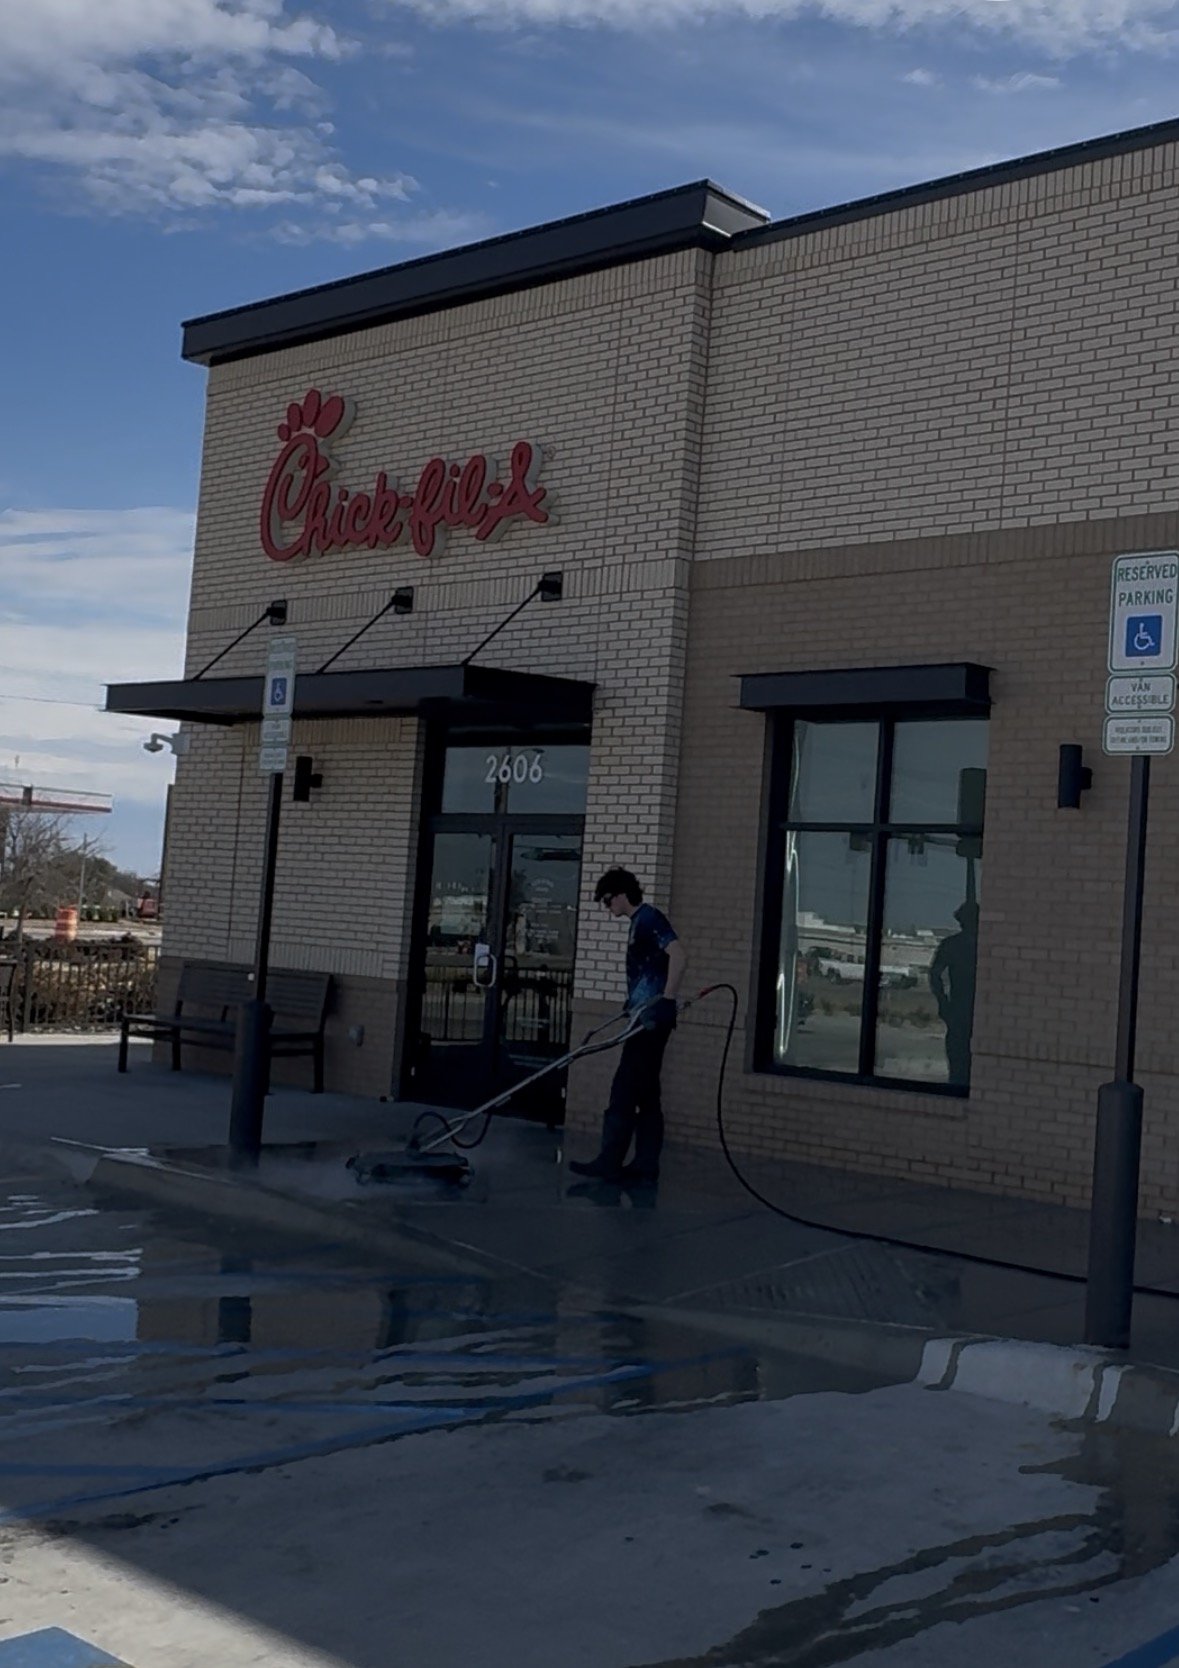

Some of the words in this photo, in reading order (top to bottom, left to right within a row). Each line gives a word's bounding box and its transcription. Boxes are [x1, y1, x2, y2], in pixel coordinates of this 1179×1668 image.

[260, 424, 549, 562] Chick-fil-A
[1117, 563, 1177, 582] RESERVED
[1118, 588, 1174, 607] PARKING
[1130, 682, 1152, 692] VAN
[1111, 694, 1169, 705] ACCESSIBLE
[484, 754, 542, 783] 2606
